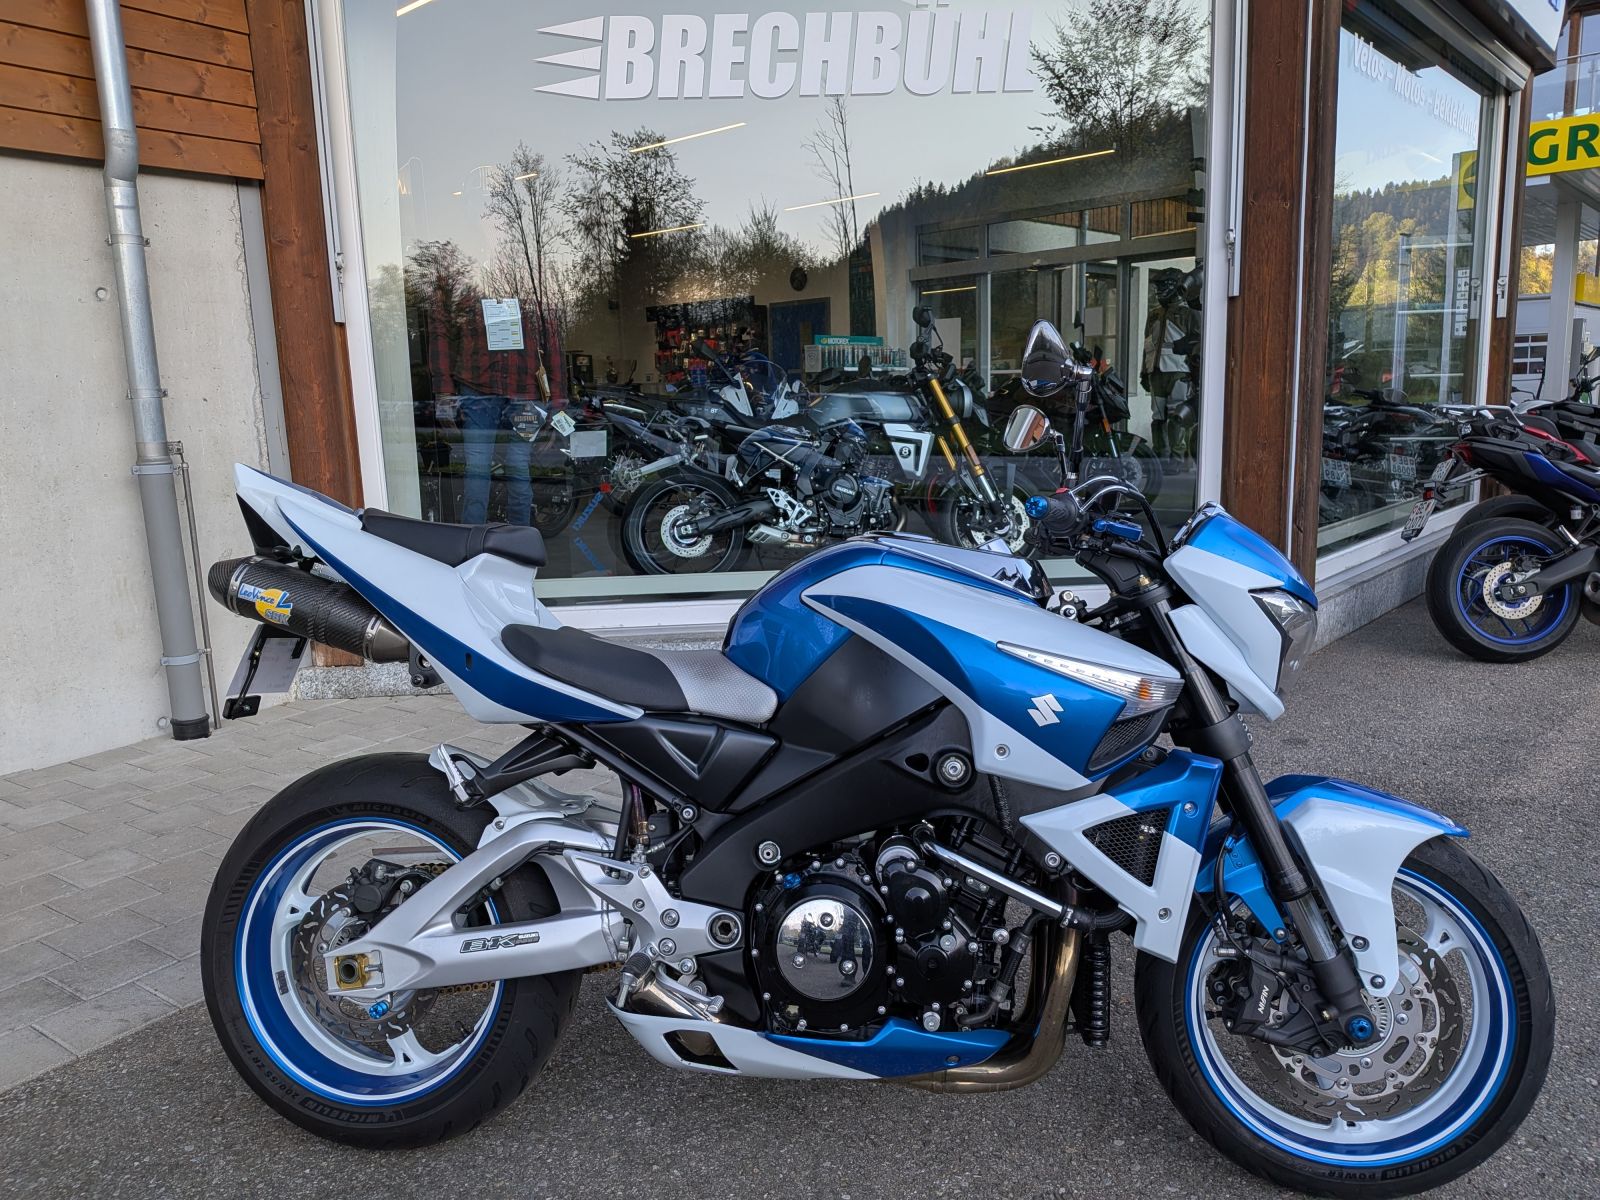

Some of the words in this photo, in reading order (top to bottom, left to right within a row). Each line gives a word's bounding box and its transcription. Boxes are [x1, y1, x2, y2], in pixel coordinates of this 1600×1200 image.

[605, 0, 1034, 100] BRECHBÜHL
[1353, 32, 1384, 81] Velos
[1394, 62, 1425, 106] Motos
